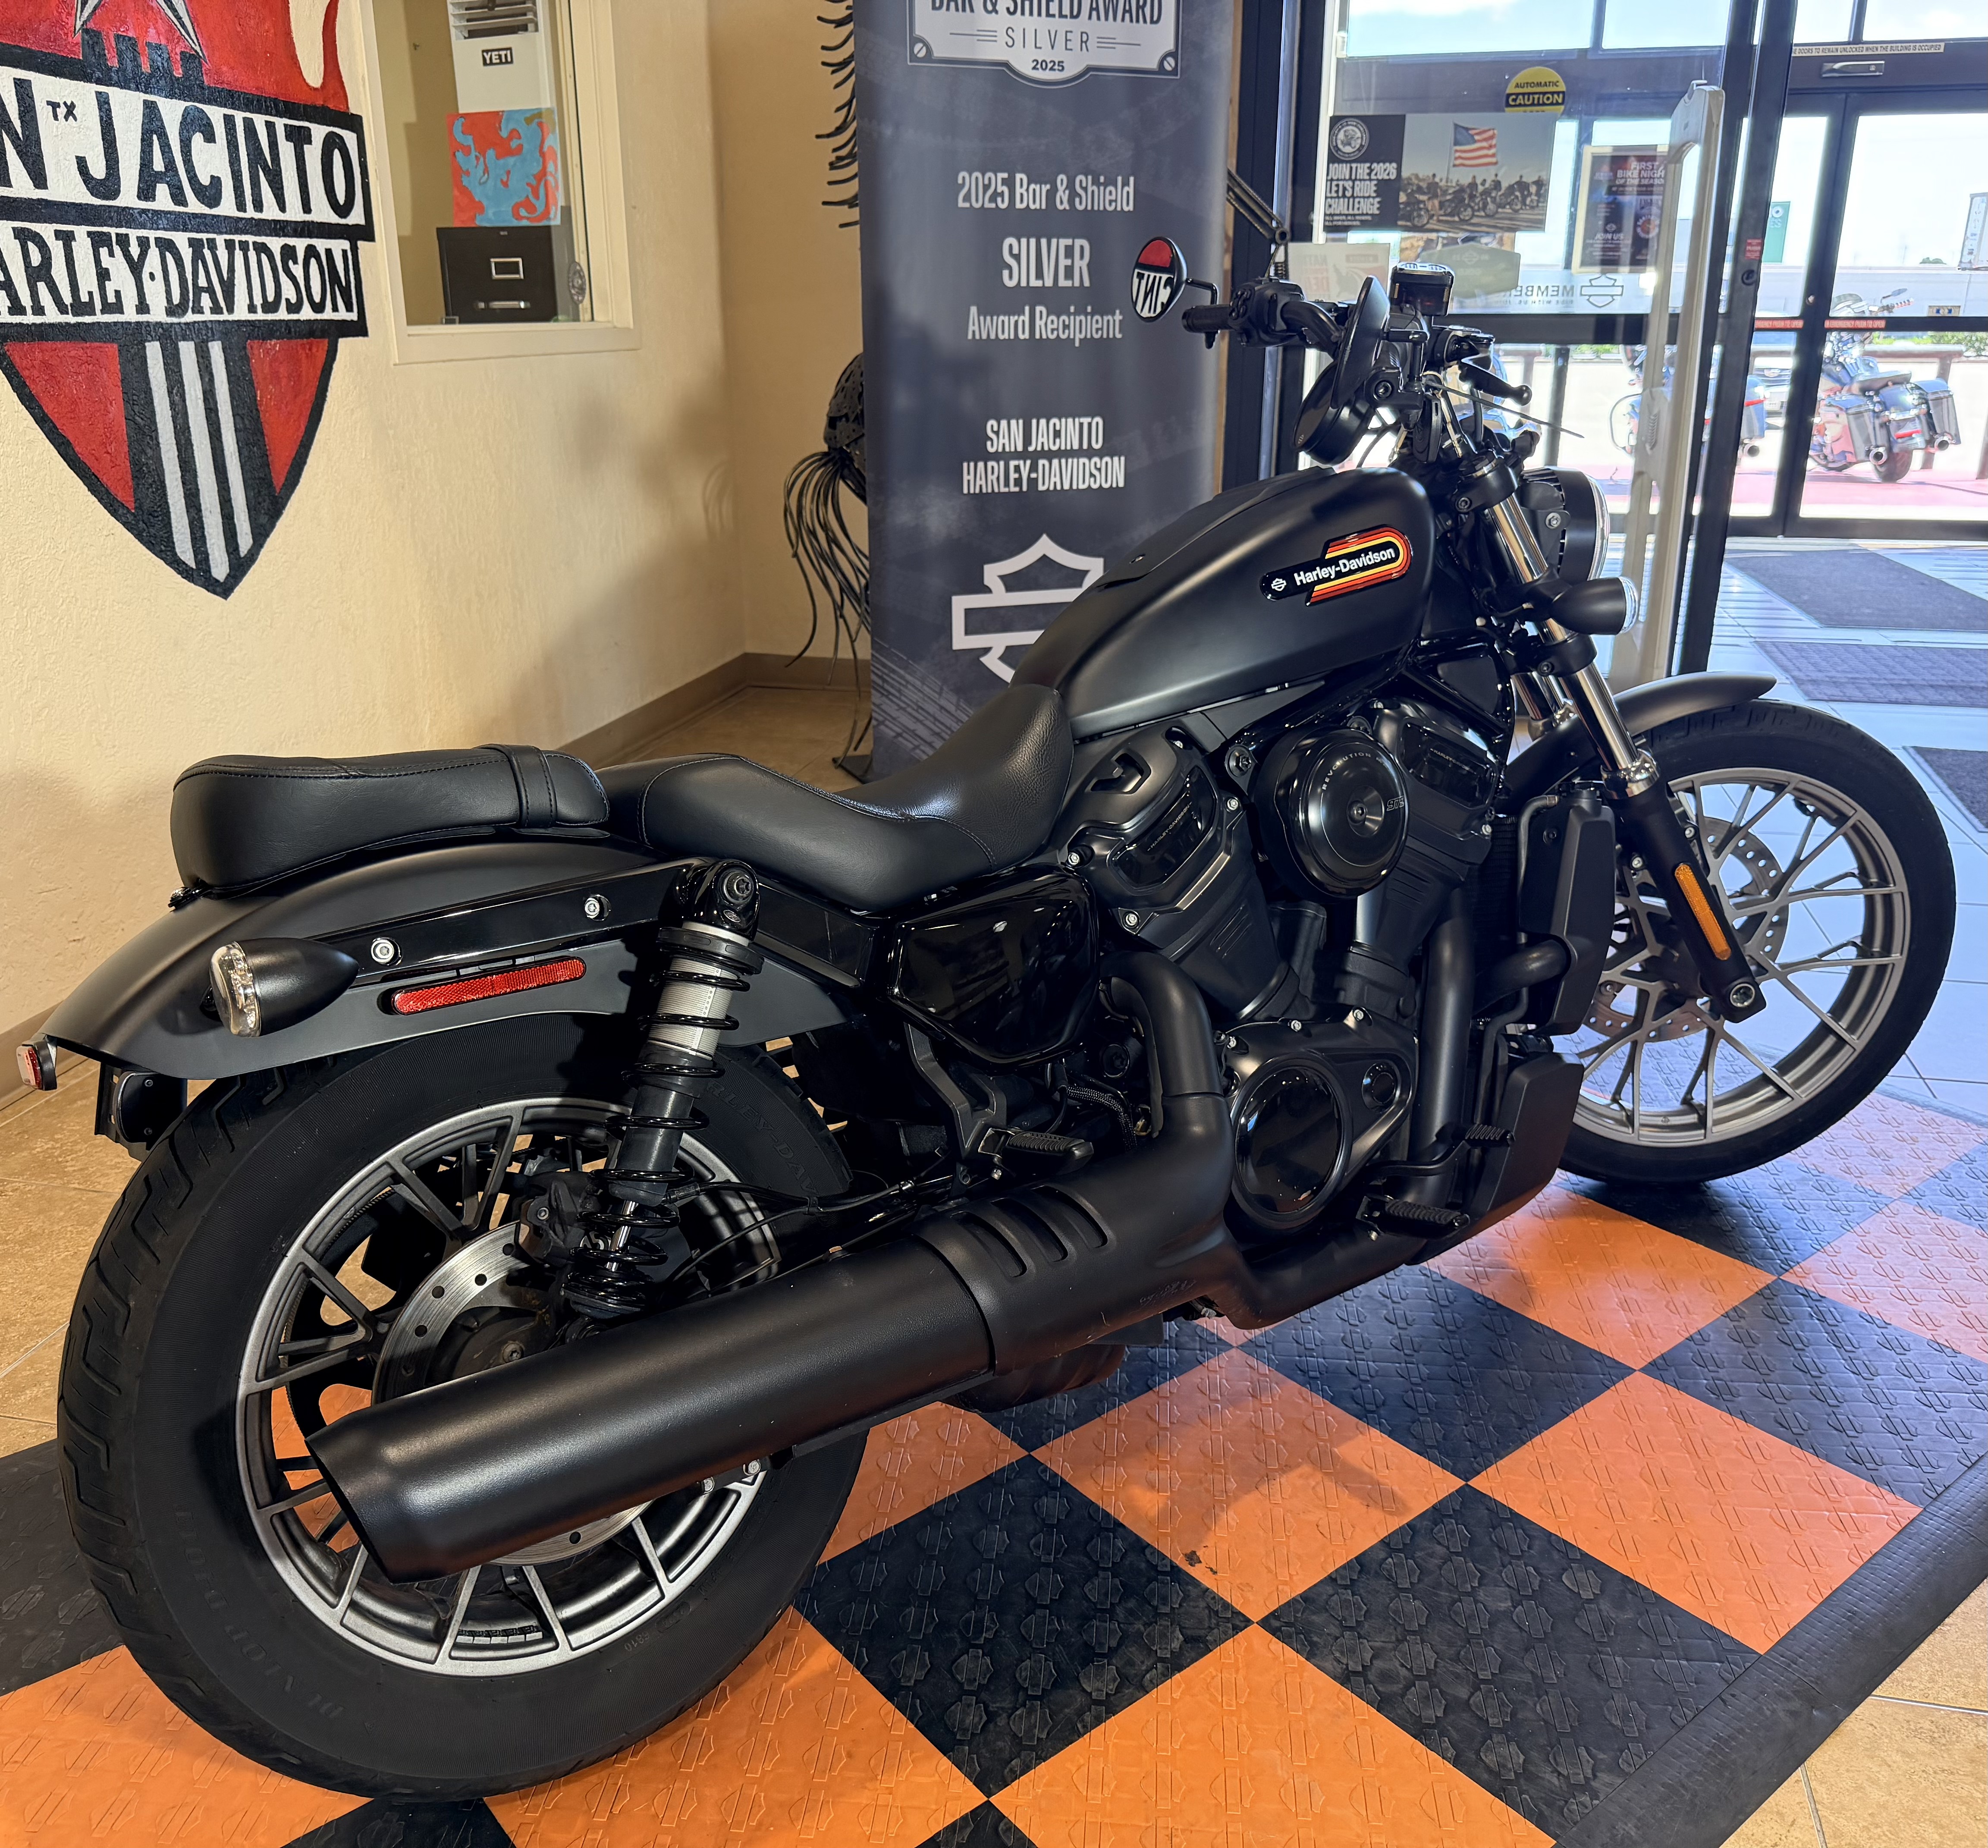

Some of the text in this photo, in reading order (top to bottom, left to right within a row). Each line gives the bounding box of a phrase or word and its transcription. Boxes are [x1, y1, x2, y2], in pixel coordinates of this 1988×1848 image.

[1005, 0, 1082, 19] SHIELD
[1088, 0, 1162, 25] AWARD
[1005, 27, 1089, 52] SILVER
[484, 50, 511, 64] YETI
[1031, 59, 1065, 72] 2025
[1514, 80, 1560, 89] AUTOMATIC
[1508, 94, 1563, 105] CAUTION
[46, 100, 78, 122] TX
[75, 91, 356, 219] JACINTO
[1327, 162, 1398, 180] JOIN THE 2026
[1617, 170, 1639, 178] BIKE
[1640, 170, 1665, 178] NIGH
[1631, 162, 1659, 170] FIRST
[958, 171, 1135, 212] 2025 Bar & Shield
[1326, 180, 1378, 197] LET'S RIDE
[1325, 197, 1382, 214] CHALLENGE
[1002, 237, 1090, 288] SILVER
[967, 305, 1123, 347] Award Recipient
[986, 416, 1104, 453] SAN JACINTO
[962, 456, 1125, 494] HARLEY-DAVIDSON
[1294, 547, 1396, 586] Harley-Davidson
